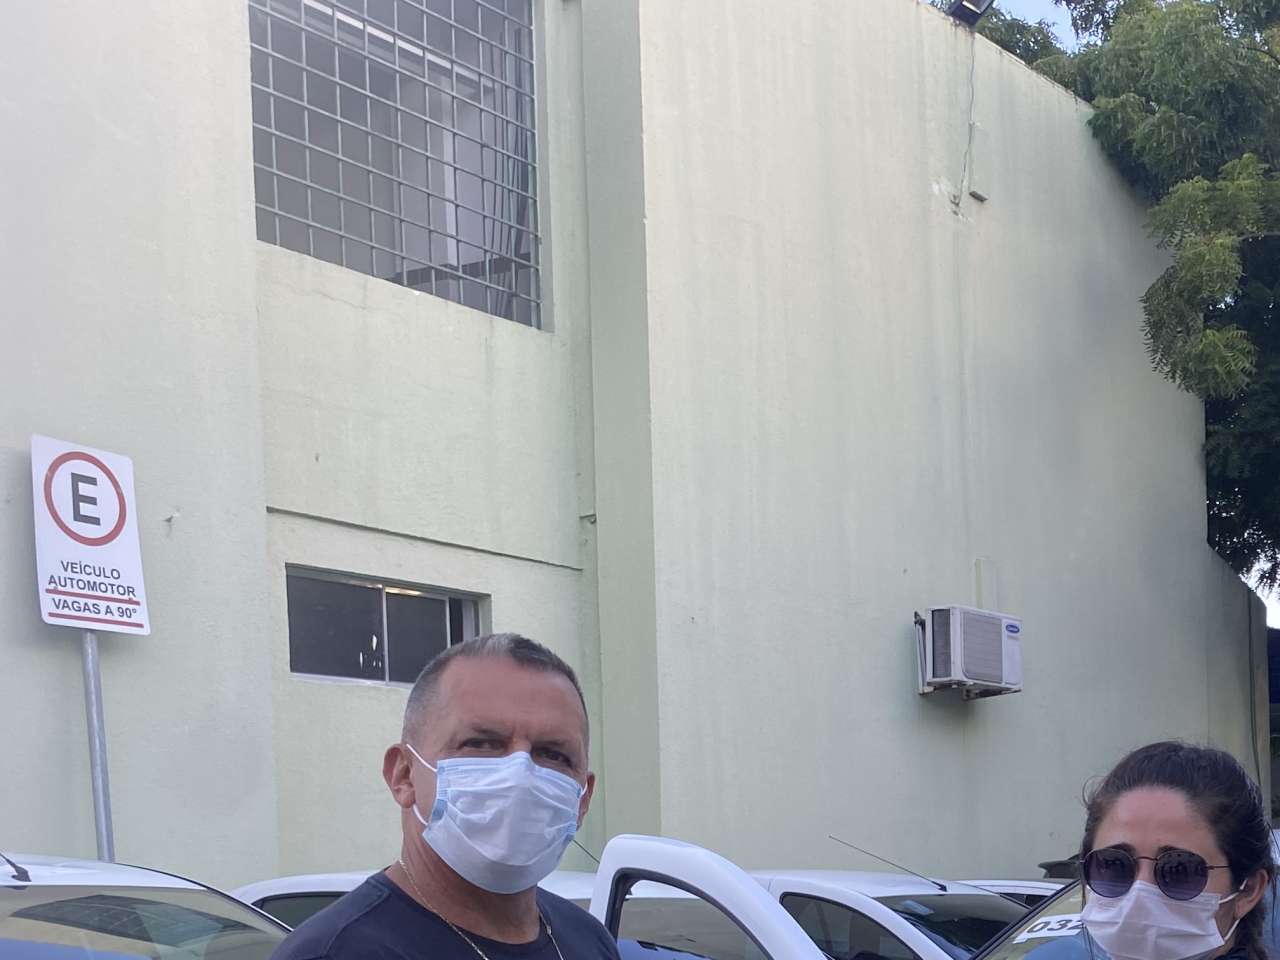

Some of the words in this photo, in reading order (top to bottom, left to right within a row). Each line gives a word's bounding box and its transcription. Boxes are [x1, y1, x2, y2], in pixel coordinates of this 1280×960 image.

[70, 472, 101, 526] E
[61, 560, 121, 580] VEÍCULO
[48, 574, 137, 598] AUTOMOTOR
[52, 597, 101, 615] VAGAS
[104, 604, 115, 617] A
